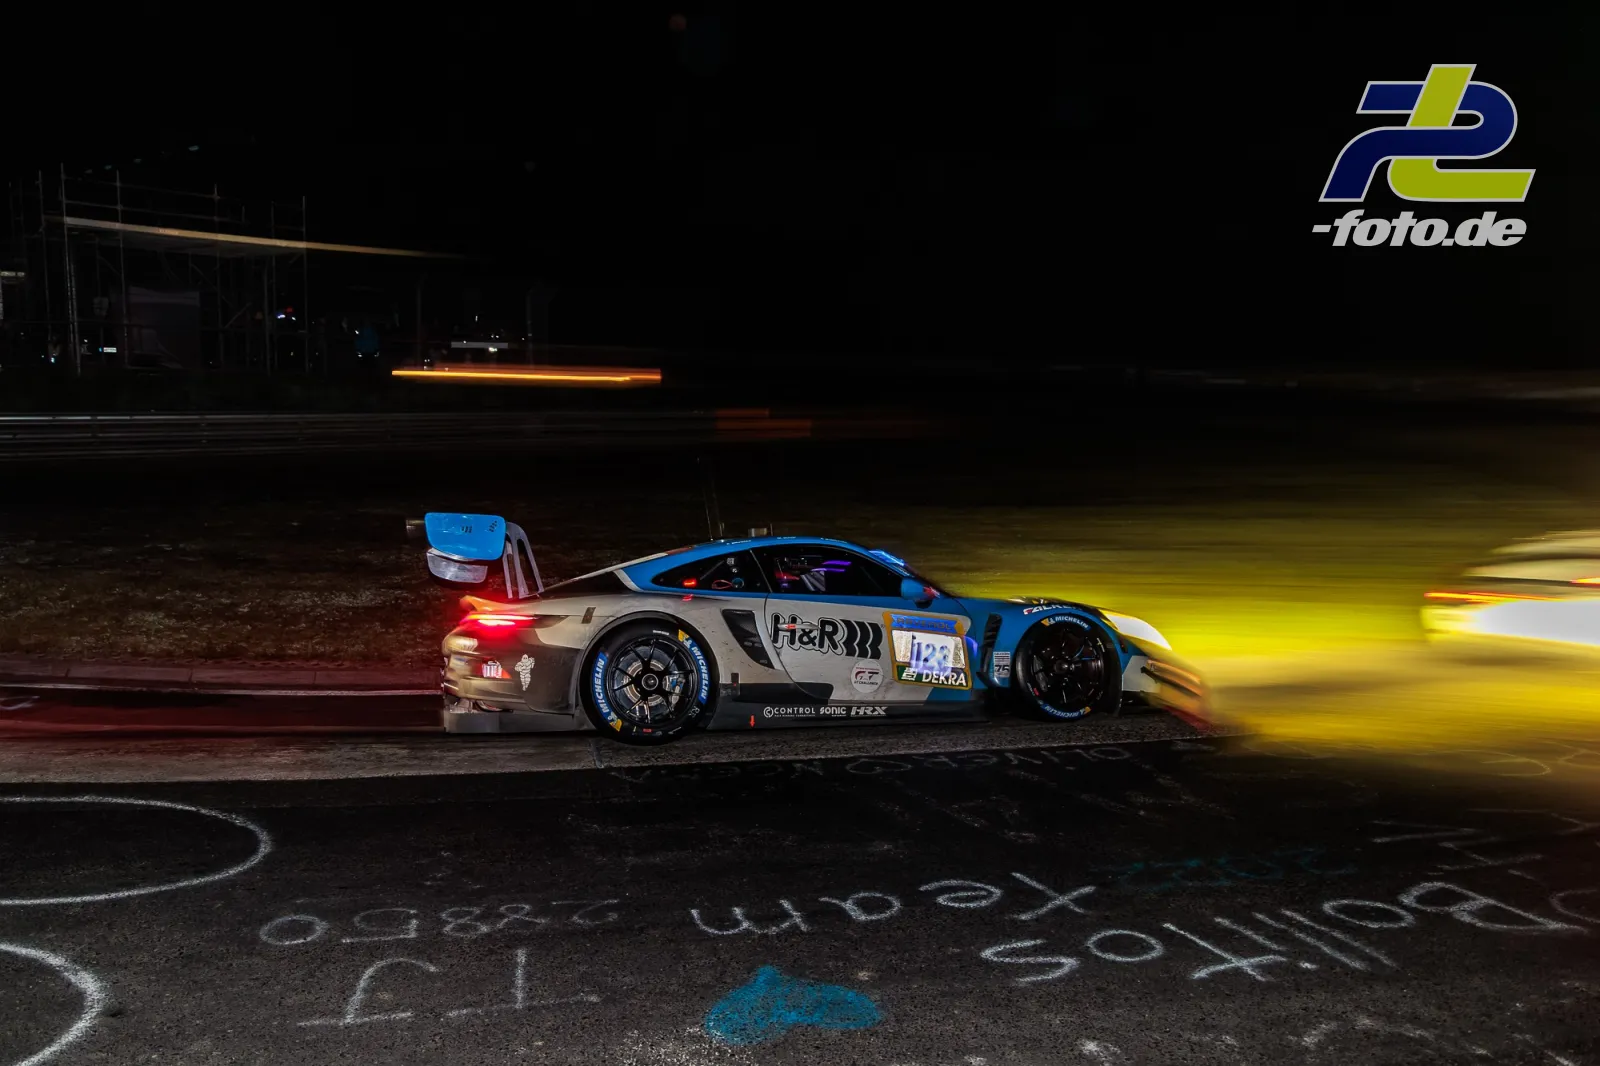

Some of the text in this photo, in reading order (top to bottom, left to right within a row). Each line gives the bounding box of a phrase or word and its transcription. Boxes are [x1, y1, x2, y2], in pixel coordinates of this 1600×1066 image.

[1055, 615, 1089, 629] MICHELIN
[771, 612, 844, 655] H&R
[690, 646, 710, 701] MICHELIN
[921, 669, 967, 687] DEKRA
[594, 658, 610, 713] MICHELIN
[850, 706, 888, 715] HRX
[1044, 705, 1080, 718] MICHELIN
